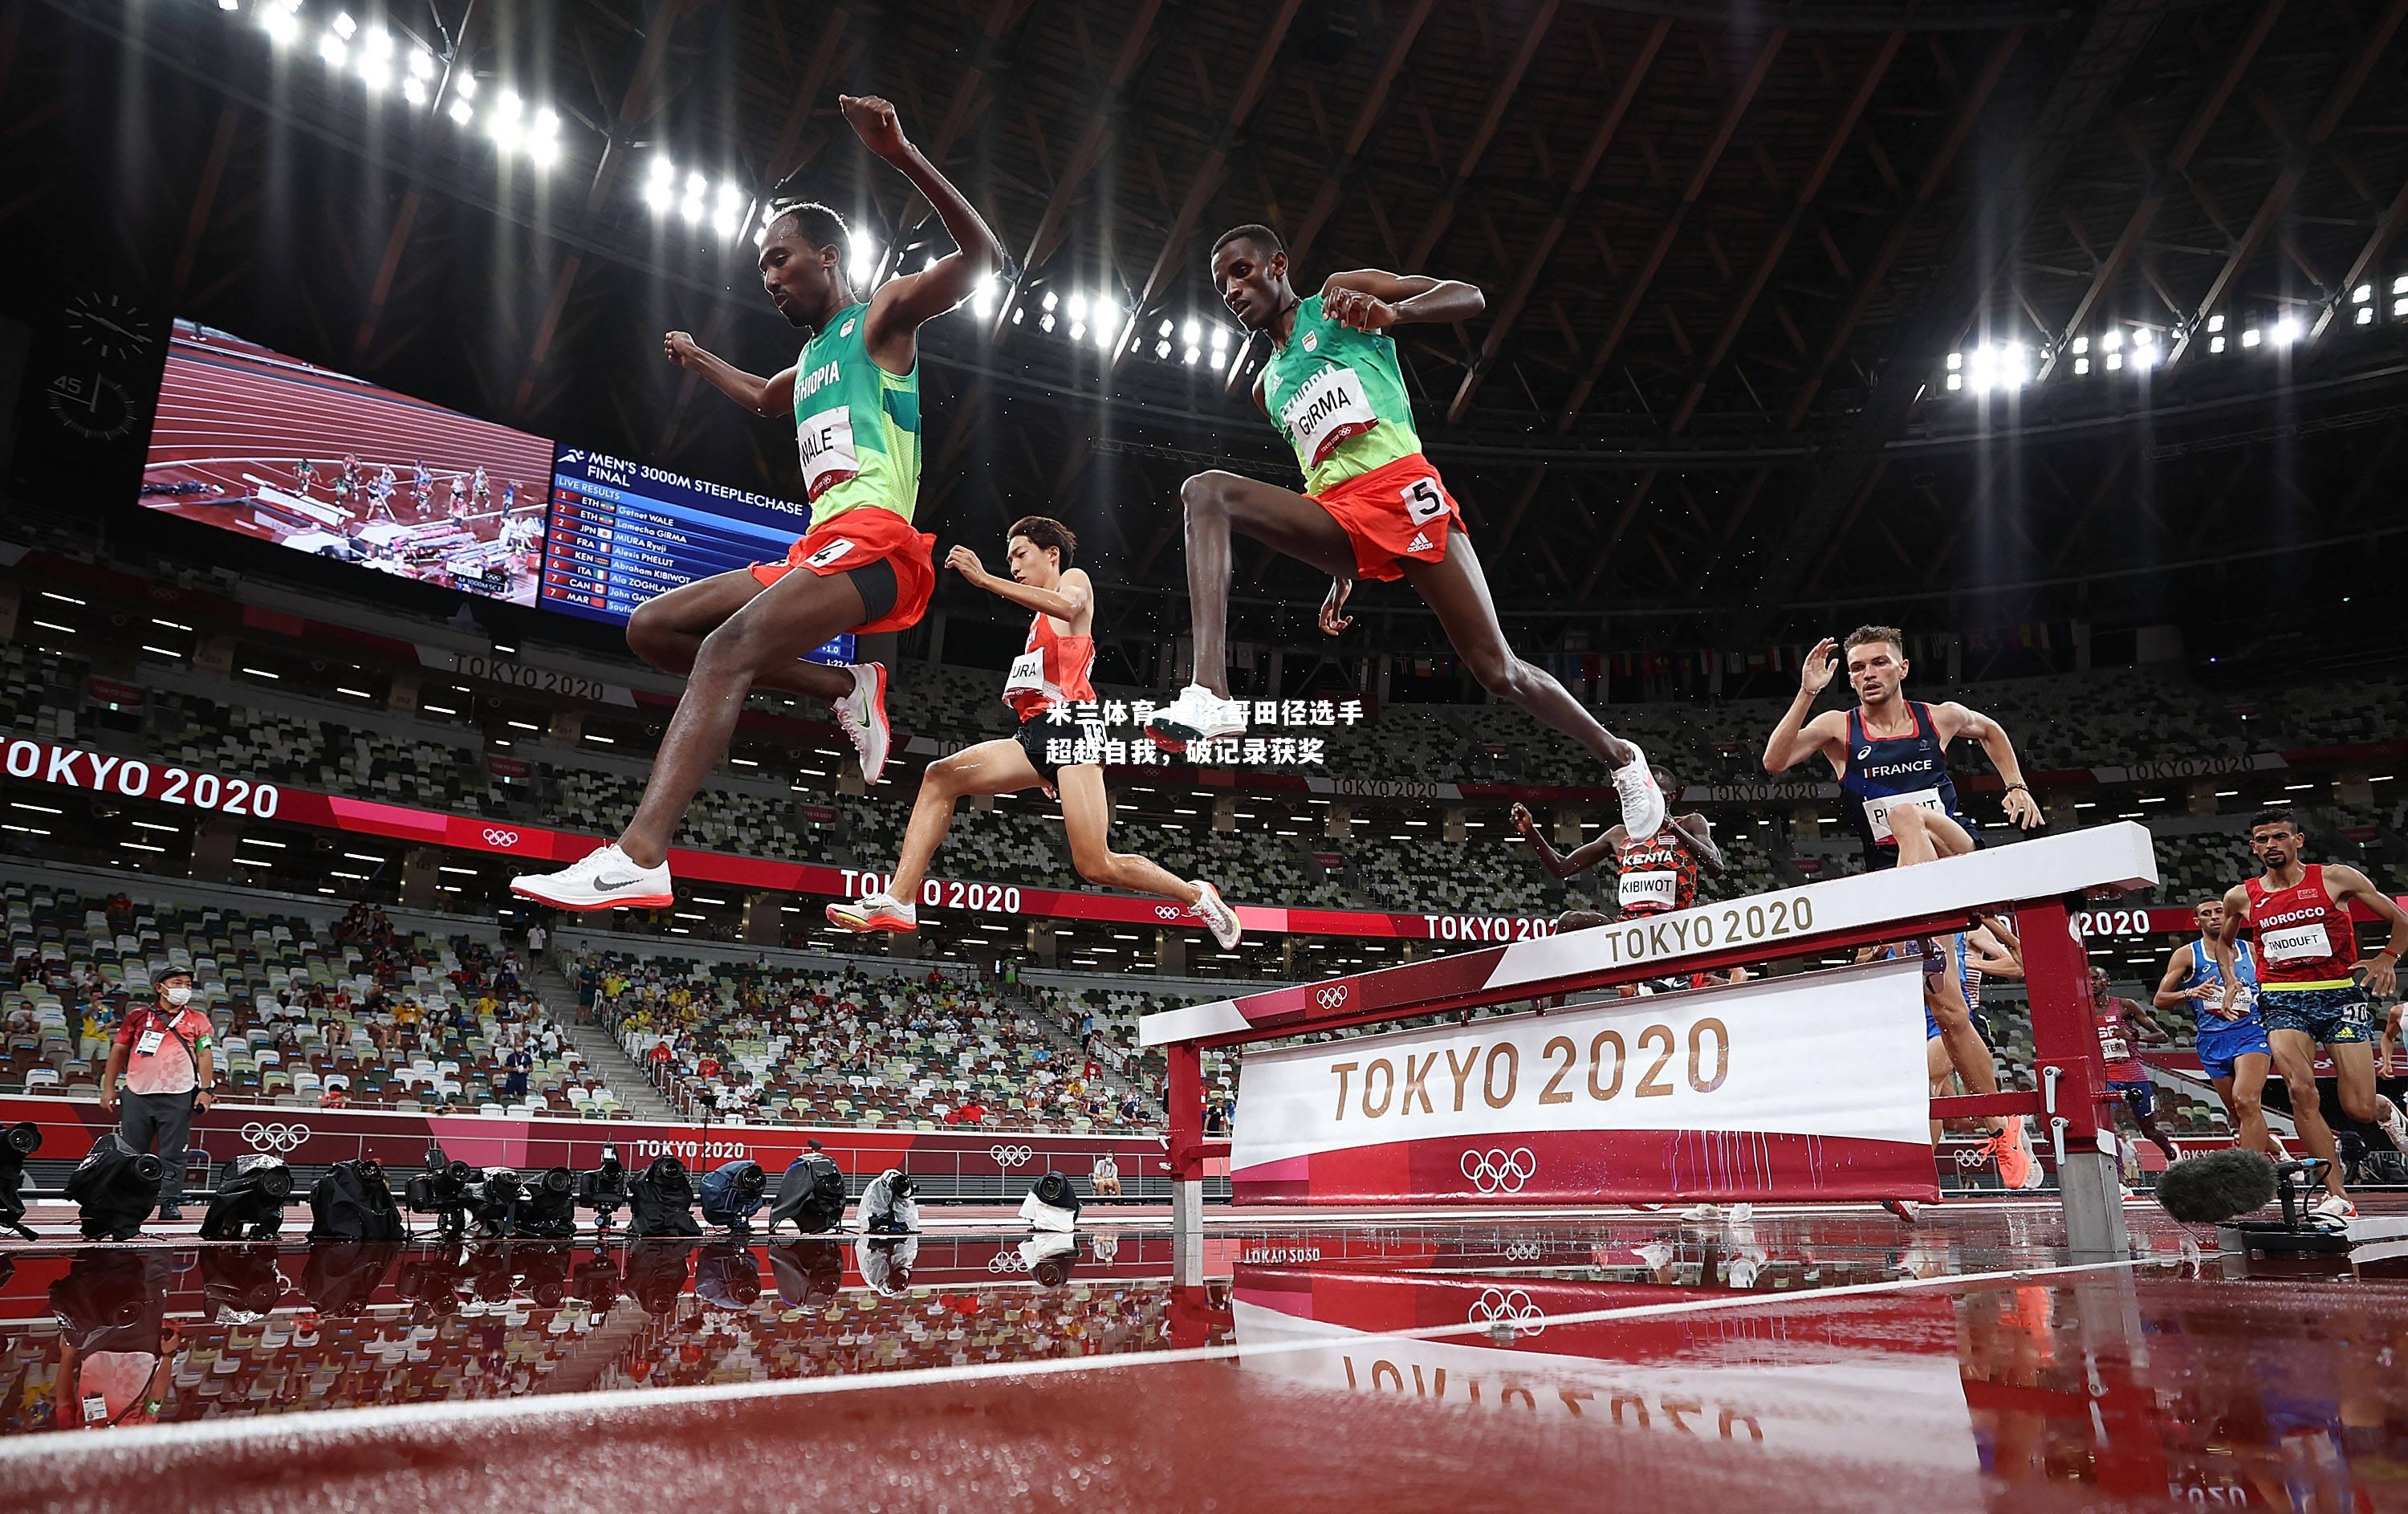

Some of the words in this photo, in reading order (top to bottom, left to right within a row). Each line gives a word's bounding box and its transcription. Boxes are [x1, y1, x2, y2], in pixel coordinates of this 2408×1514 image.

[54, 374, 83, 394] 45
[1299, 387, 1352, 435] GIRMA
[799, 427, 834, 467] WALE
[559, 477, 580, 490] LIVE
[582, 482, 620, 500] RESULTS
[588, 465, 631, 487] FINAL
[589, 452, 637, 474] MEN'S
[641, 466, 691, 489] 3000M
[695, 479, 804, 516] STEEPLECHASE
[1413, 482, 1440, 515] 5
[559, 505, 566, 513] 2
[580, 511, 598, 522] ETH
[617, 520, 655, 535] Lamecha
[657, 530, 688, 543] GIRMA
[582, 497, 600, 509] ETH
[618, 506, 648, 521] Getnet
[649, 514, 674, 527] WALE
[558, 519, 564, 527] 2
[580, 524, 596, 535] JPN
[616, 534, 645, 547] MIURA
[646, 540, 667, 553] Ryuji
[1407, 542, 1434, 552] adidas
[556, 532, 563, 540] 4
[576, 538, 595, 549] FRA
[614, 547, 640, 560] Alexis
[641, 554, 674, 568] PHELUT
[813, 543, 844, 562] 4
[553, 560, 559, 568] 6
[577, 566, 592, 576] ITA
[612, 575, 627, 584] Ala
[555, 546, 561, 555] 5
[575, 551, 593, 563] KEN
[612, 560, 653, 576] Abraham
[654, 570, 691, 584] KIBIWOT
[550, 588, 556, 596] 7
[567, 592, 589, 604] MAR
[551, 574, 558, 582] 7
[569, 579, 591, 590] CAN
[610, 588, 630, 600] John
[454, 653, 537, 687] TOKYO
[545, 674, 603, 701] 2020
[0, 736, 149, 796] OKYO
[161, 768, 279, 818] 2020
[1872, 759, 1932, 777] FRANCE
[2121, 760, 2193, 782] TOKYO
[2200, 756, 2254, 775] 2020
[1332, 779, 1389, 796] TOKYO
[1395, 782, 1437, 797] 2020
[1707, 785, 1767, 801] TOKYO
[1774, 783, 1818, 800] 2020
[1622, 850, 1674, 866] KENYA
[840, 869, 941, 906] TOO
[949, 882, 1020, 914] 2020
[1621, 880, 1672, 893] KIBIWOT
[1424, 915, 1510, 941] TOKYO
[1605, 916, 1714, 962] TOKYO
[1723, 897, 1813, 943] 2020
[2080, 910, 2150, 936] 2020
[2259, 906, 2325, 929] MOROCCO
[2268, 934, 2318, 951] TINDOUFT
[2347, 1004, 2366, 1023] 10
[1330, 1042, 1519, 1121] TOKYO
[1539, 1019, 1729, 1105] 2020
[637, 1139, 698, 1158] TOKYO
[701, 1142, 744, 1158] 2020
